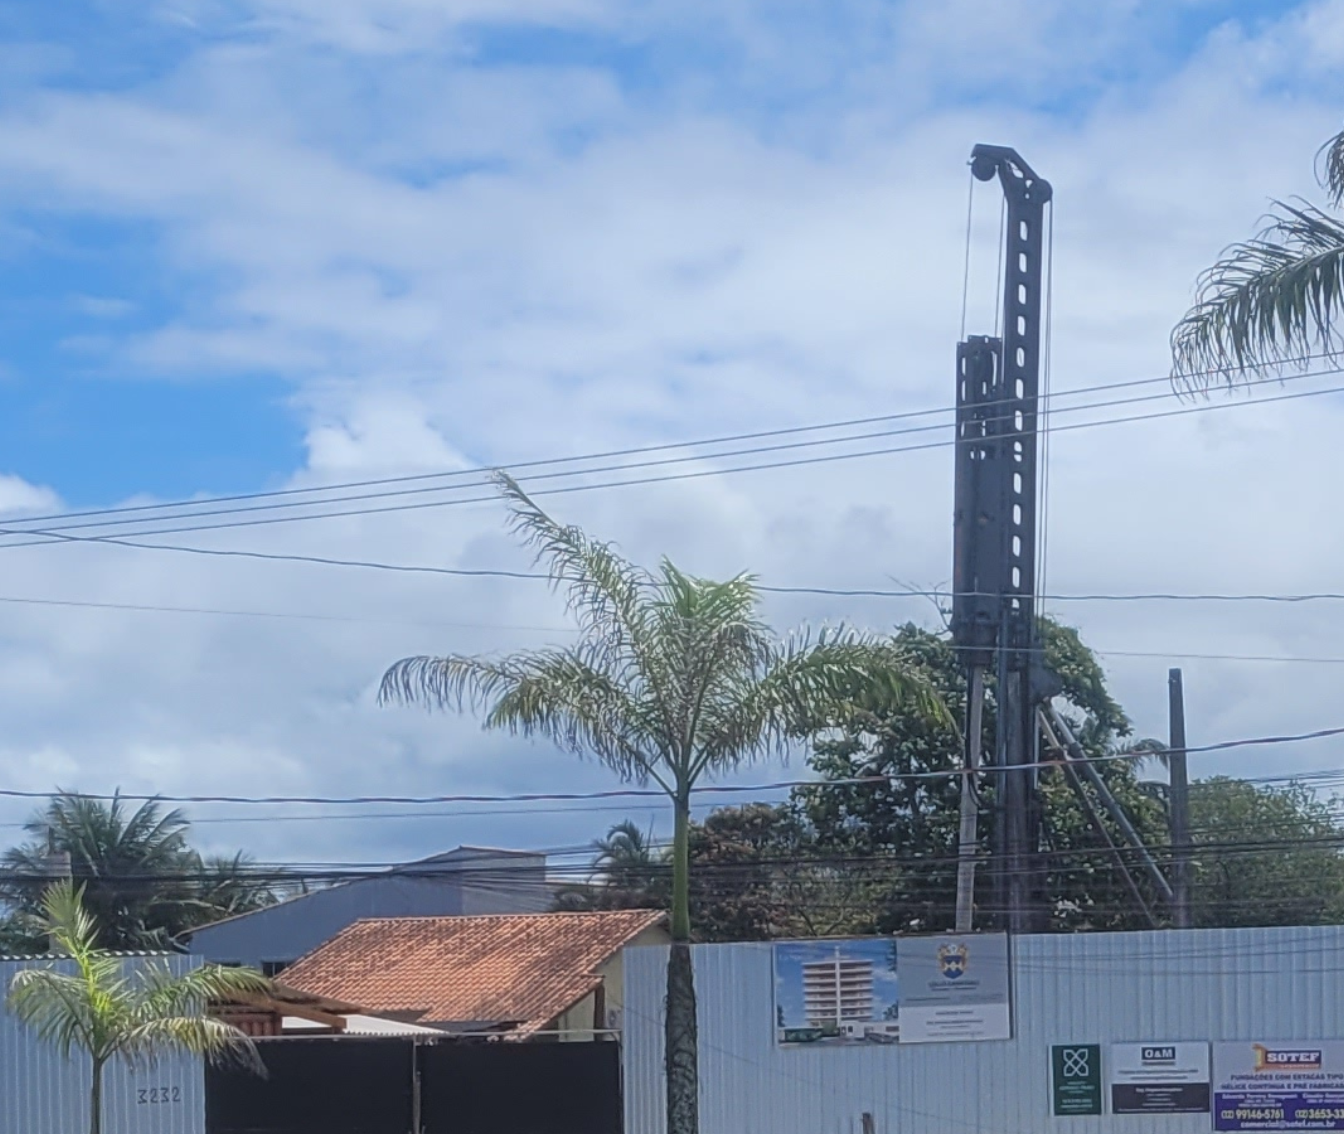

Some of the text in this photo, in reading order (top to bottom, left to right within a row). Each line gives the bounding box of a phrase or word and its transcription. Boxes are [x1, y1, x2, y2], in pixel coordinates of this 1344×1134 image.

[1266, 1052, 1320, 1062] SOTEF
[137, 1086, 181, 1104] 3232
[1236, 1108, 1284, 1119] 99146-5761
